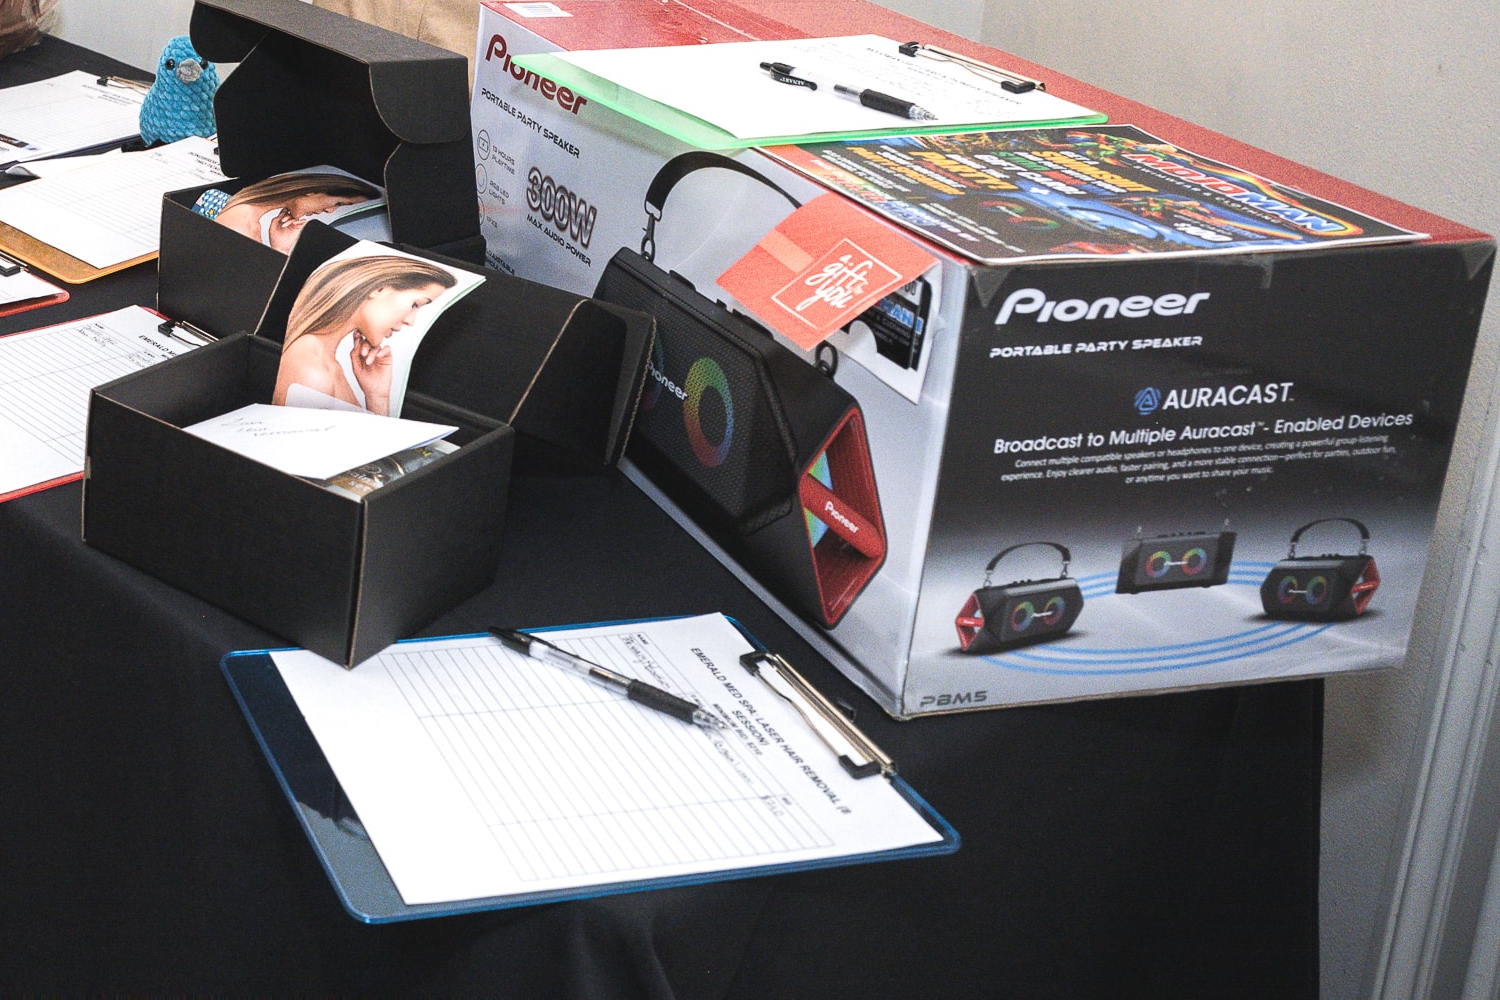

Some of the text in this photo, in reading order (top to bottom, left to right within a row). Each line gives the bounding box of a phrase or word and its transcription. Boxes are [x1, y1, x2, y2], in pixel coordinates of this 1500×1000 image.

[485, 33, 588, 115] Pioneer
[481, 88, 580, 158] PORTABLE PARTY SPEAKER
[904, 149, 1022, 191] PARTY!
[970, 153, 1089, 195] GIFT CARD!
[1027, 149, 1162, 194] SWIMSUIT
[526, 166, 597, 249] 300W
[1119, 152, 1348, 232] MOJOMAN
[527, 213, 592, 267] MAX AUDIO POWER
[795, 278, 854, 311] you
[804, 260, 873, 291] gift
[994, 287, 1211, 325] Pioneer
[989, 336, 1203, 358] PORTABLE PARTY SPEAKER
[1162, 382, 1294, 410] AURACAST
[994, 432, 1082, 454] Broadcast
[1087, 432, 1105, 447] to
[1109, 427, 1176, 445] Multiple
[1274, 415, 1344, 434] Enabled
[1348, 412, 1413, 429] Devices
[825, 501, 859, 533] Pioneer
[920, 690, 988, 707] PBM5
[689, 647, 729, 681] EMERALD
[721, 682, 745, 698] MED
[753, 717, 787, 743] LASER
[778, 744, 806, 763] HAIR
[797, 765, 844, 804] REMOVAL
[729, 710, 771, 746] SESSION)
